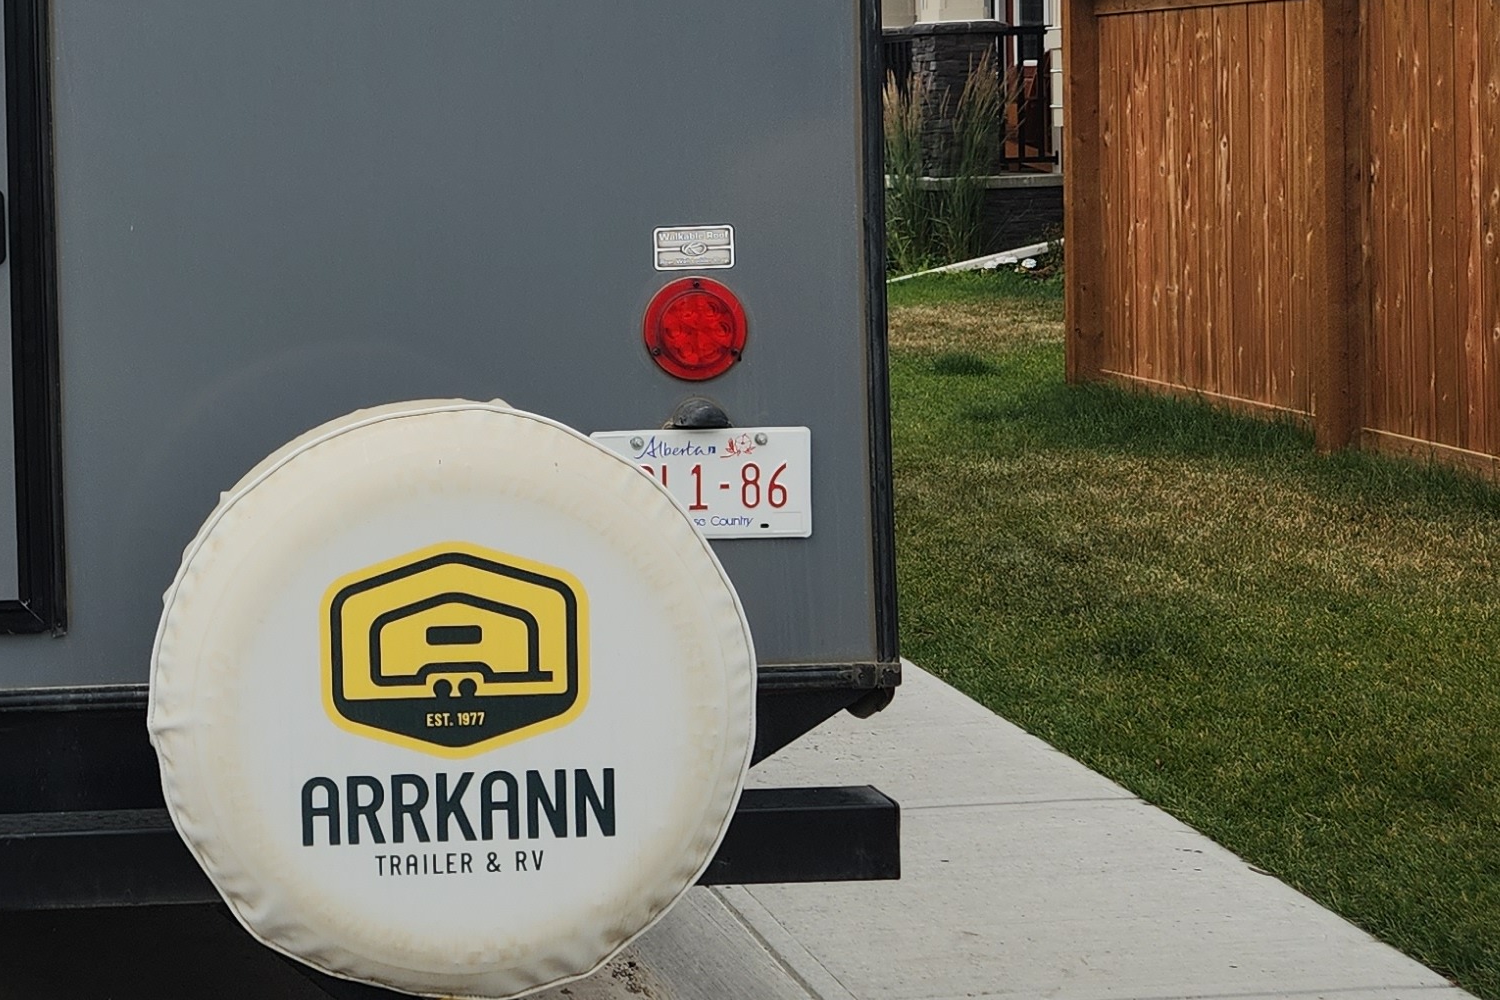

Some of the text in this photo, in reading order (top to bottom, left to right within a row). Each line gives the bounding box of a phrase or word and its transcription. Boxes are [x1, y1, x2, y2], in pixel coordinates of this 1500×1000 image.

[634, 435, 708, 459] Alberta
[710, 515, 754, 528] Country
[426, 711, 485, 727] EST. 1977
[301, 768, 616, 846] ARRKANN
[375, 850, 544, 876] TRAILER & RV
